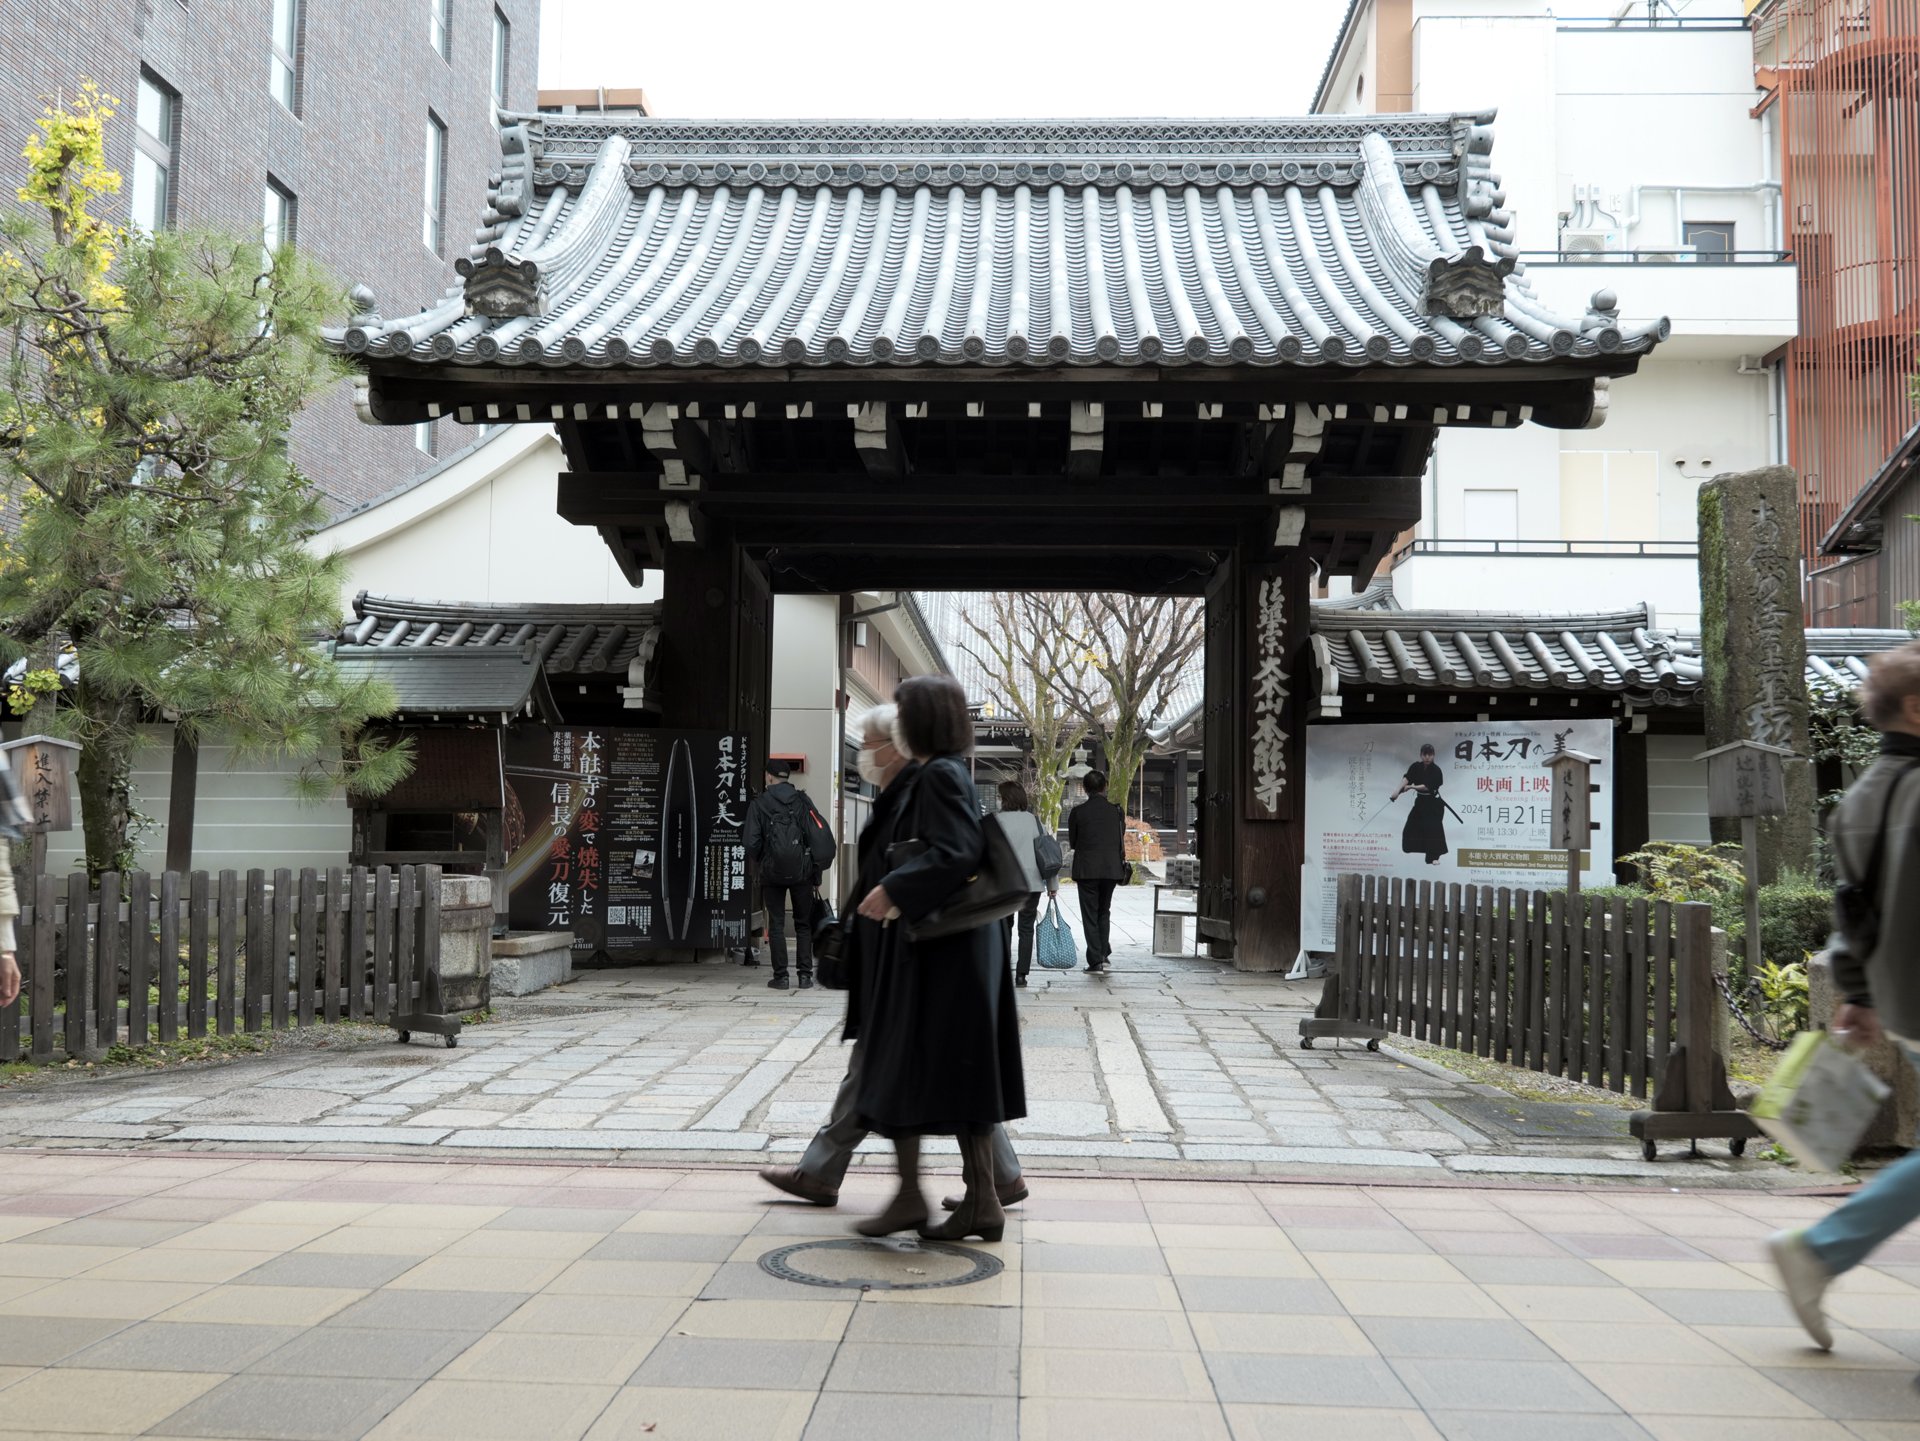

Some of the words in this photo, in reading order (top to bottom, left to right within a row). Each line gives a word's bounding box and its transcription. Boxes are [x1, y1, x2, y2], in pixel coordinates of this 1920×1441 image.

[33, 752, 53, 826] 進入禁止
[711, 735, 744, 828] 日本刀の美
[1461, 804, 1483, 814] 2024
[547, 782, 572, 927] 信長の愛刀復元
[1497, 827, 1518, 836] 13:30
[731, 845, 746, 890] 特別展
